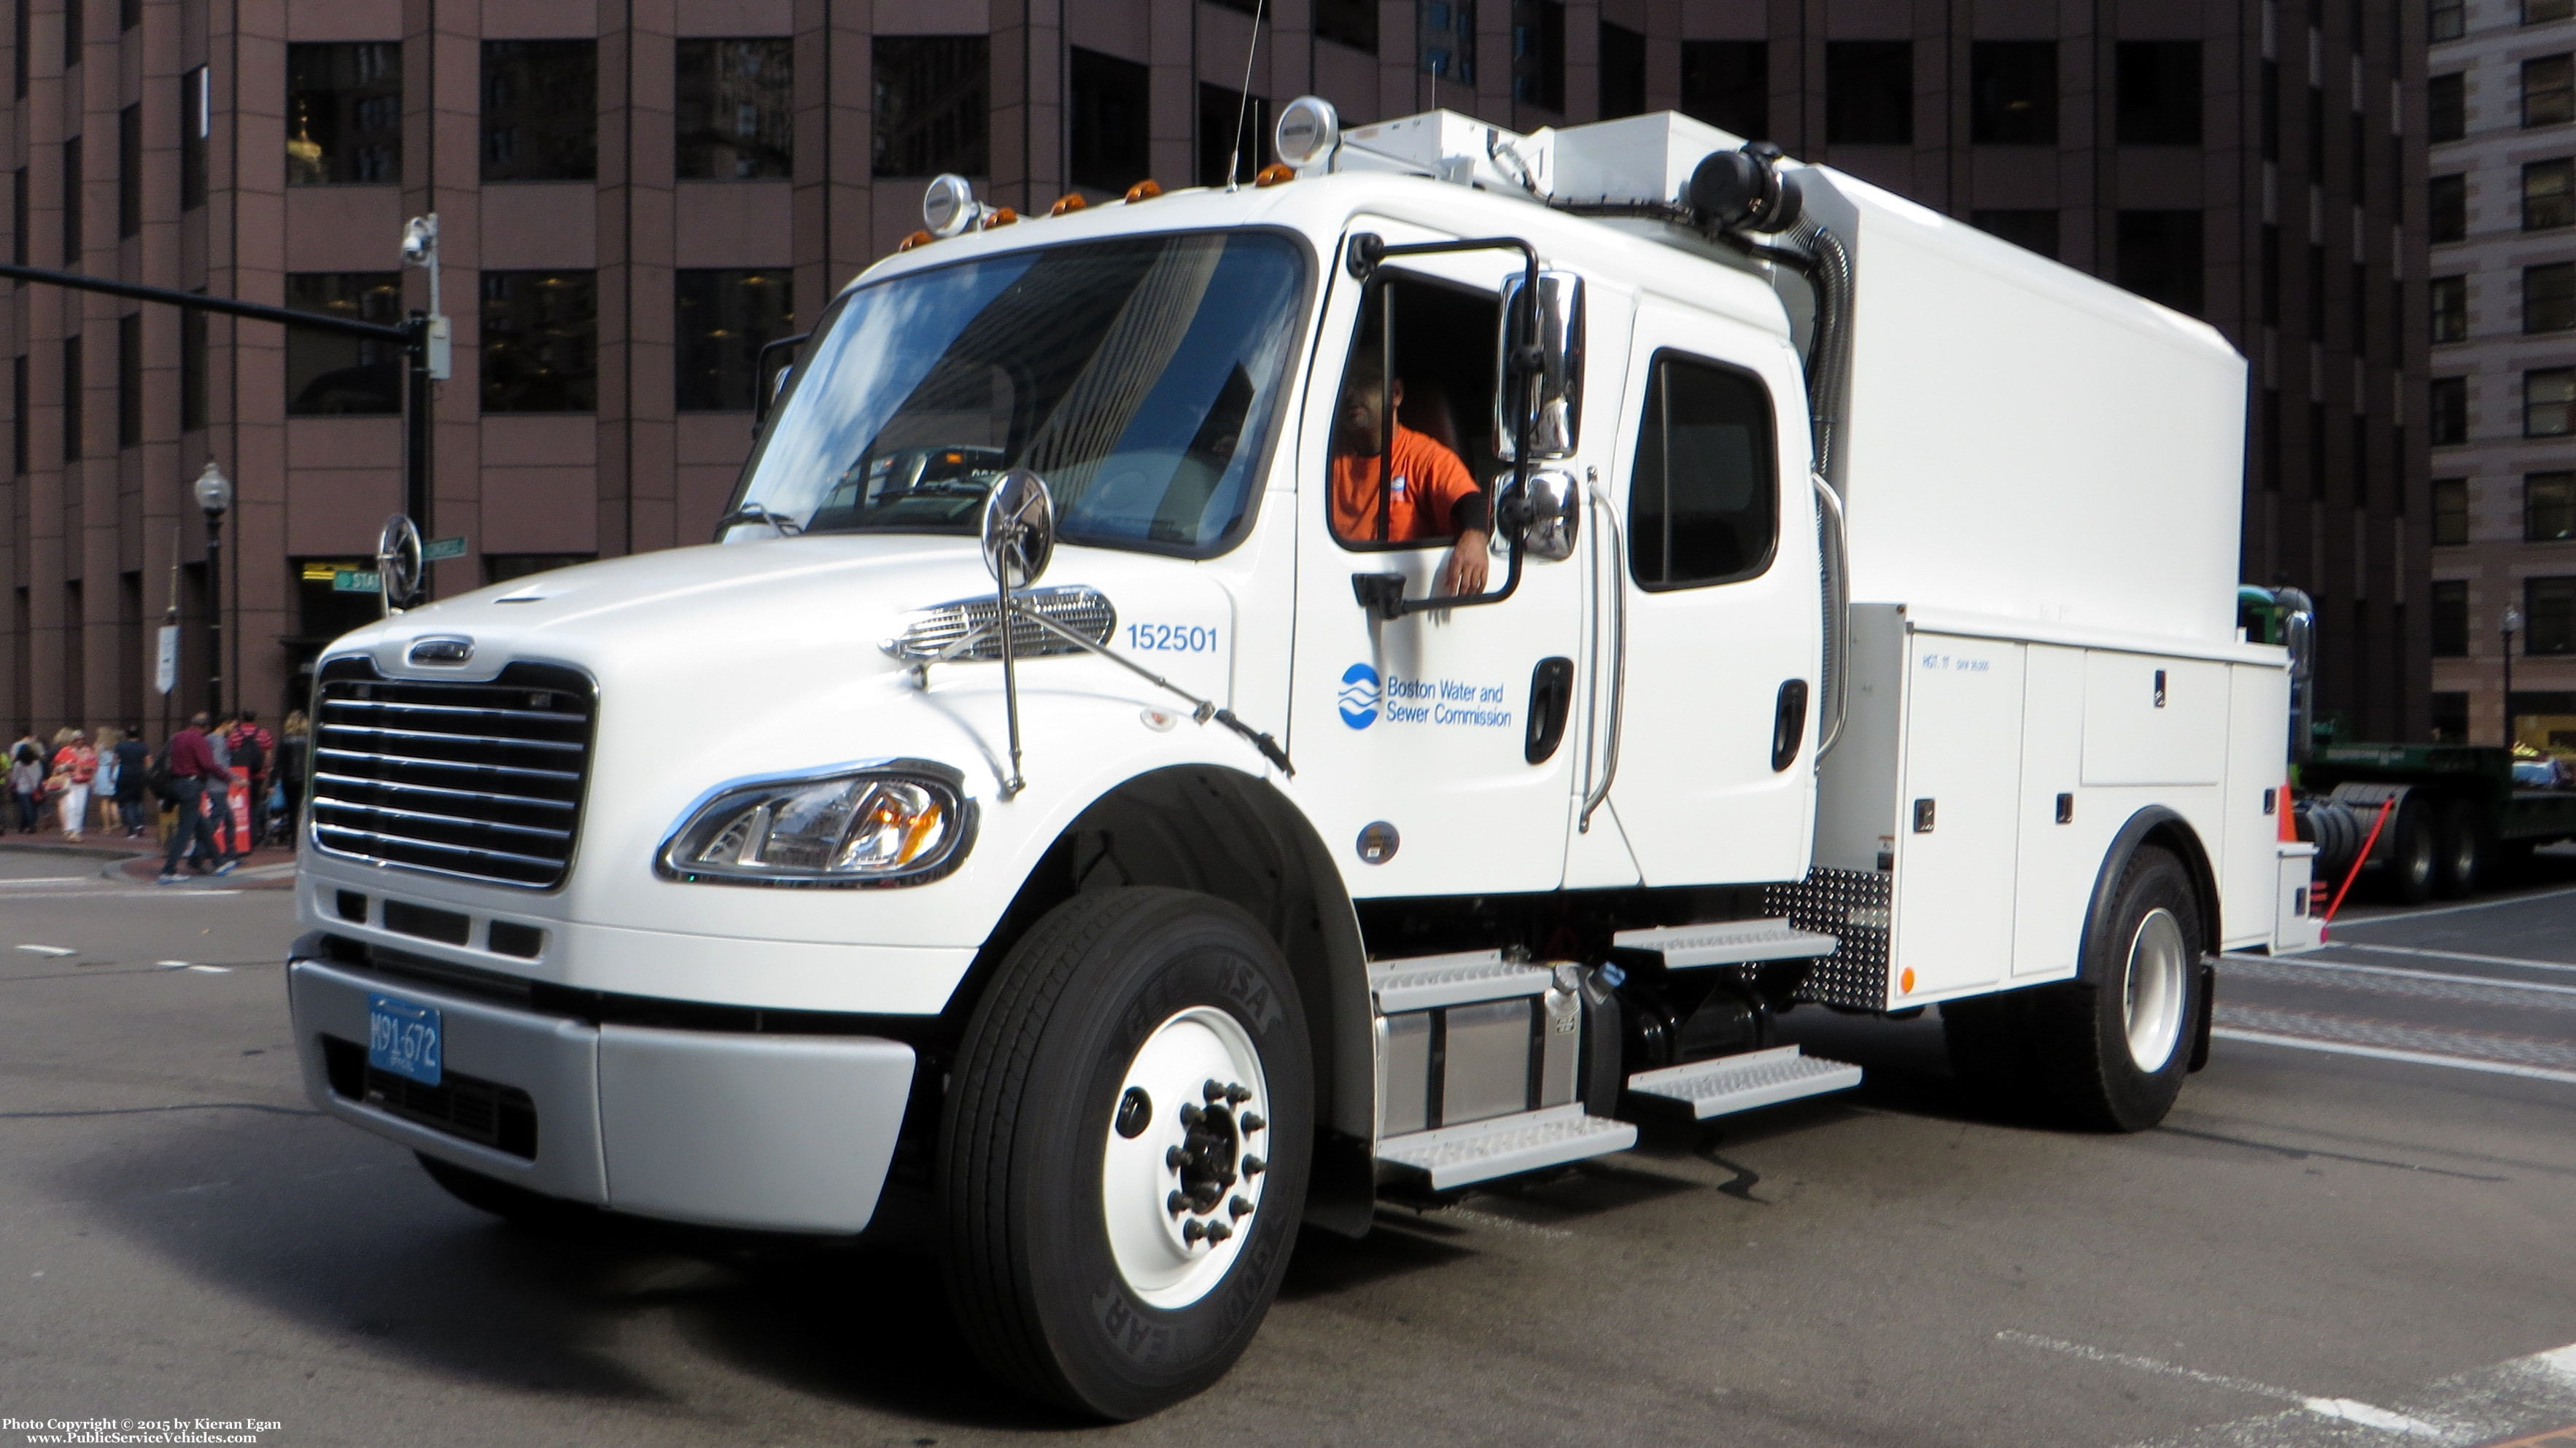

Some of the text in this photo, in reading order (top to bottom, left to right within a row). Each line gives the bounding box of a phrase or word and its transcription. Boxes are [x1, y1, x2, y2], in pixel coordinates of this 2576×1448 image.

[1127, 623, 1217, 653] 152501
[1388, 676, 1504, 703] Boston Water and
[1387, 700, 1512, 727] Sewer Commission
